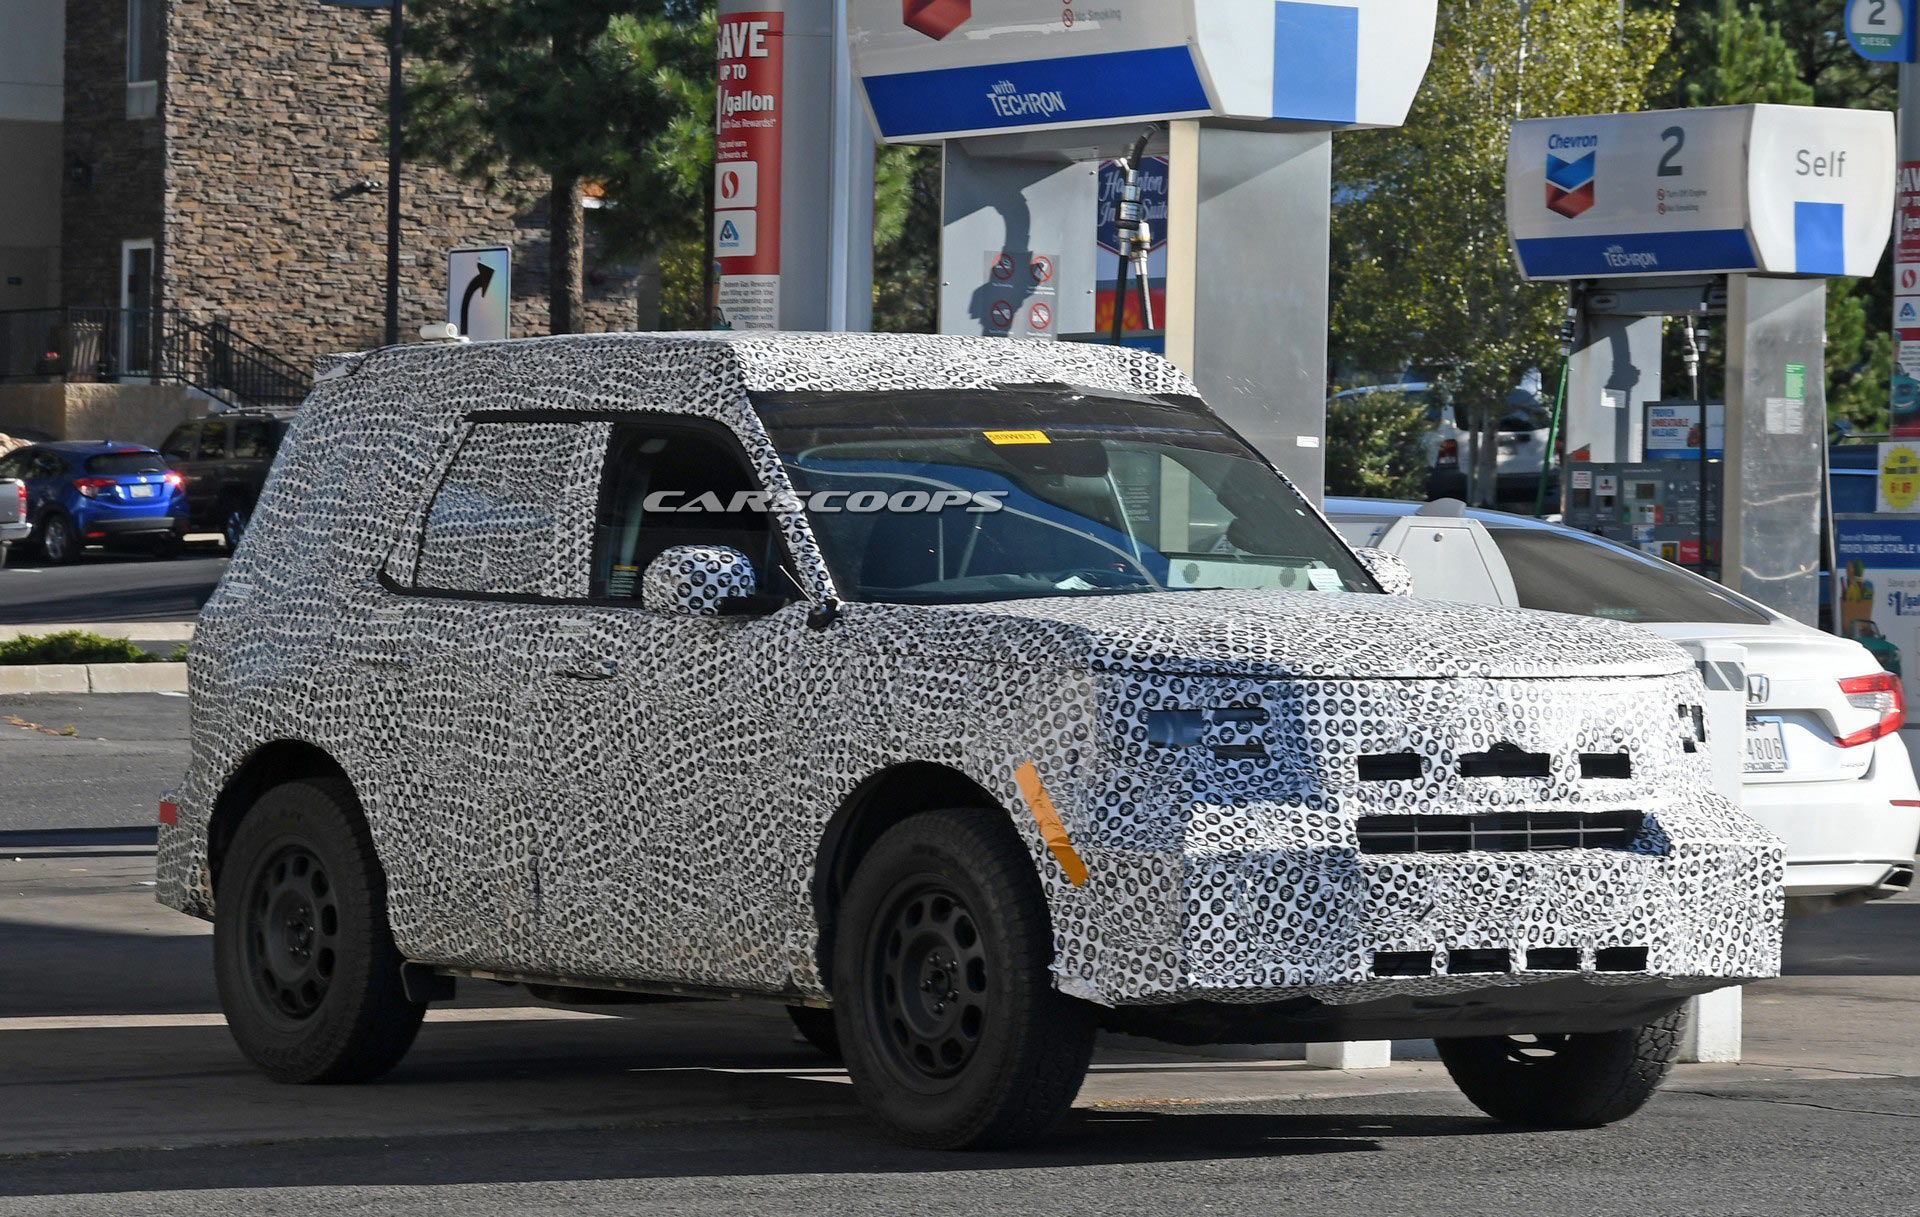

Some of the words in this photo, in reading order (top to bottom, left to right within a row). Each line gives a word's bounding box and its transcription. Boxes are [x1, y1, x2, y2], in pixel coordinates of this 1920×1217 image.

[732, 63, 747, 80] TO
[991, 80, 1017, 95] with
[986, 91, 1067, 118] TECHRON
[1548, 134, 1598, 150] Chevron
[1657, 125, 1686, 177] 2
[1795, 149, 1847, 178] Self
[1603, 252, 1659, 269] TECHRON
